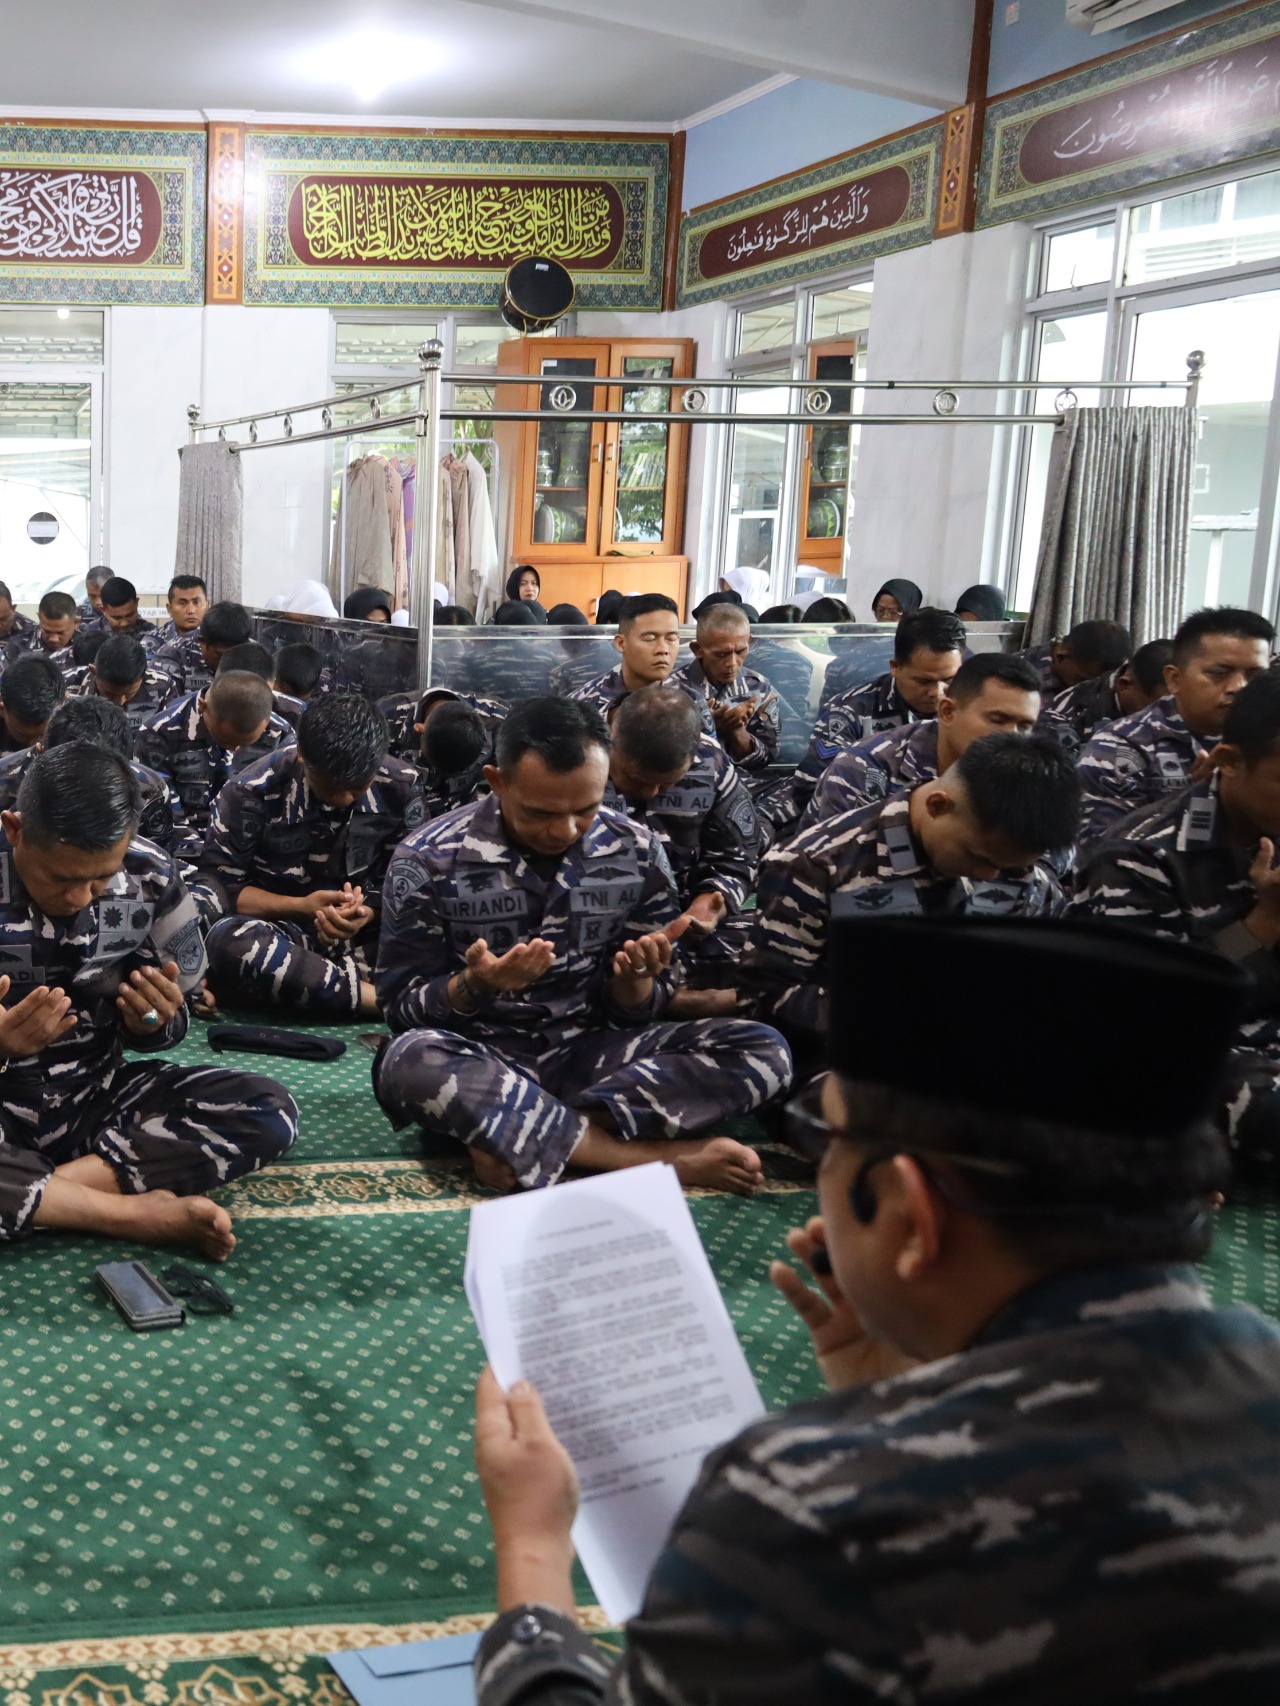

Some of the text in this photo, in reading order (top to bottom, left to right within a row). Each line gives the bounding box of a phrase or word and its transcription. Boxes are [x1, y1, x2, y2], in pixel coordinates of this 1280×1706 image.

[659, 794, 682, 808] TNI
[690, 795, 711, 809] AL
[442, 895, 522, 917] LIRIANDI
[578, 889, 637, 907] TNI AL
